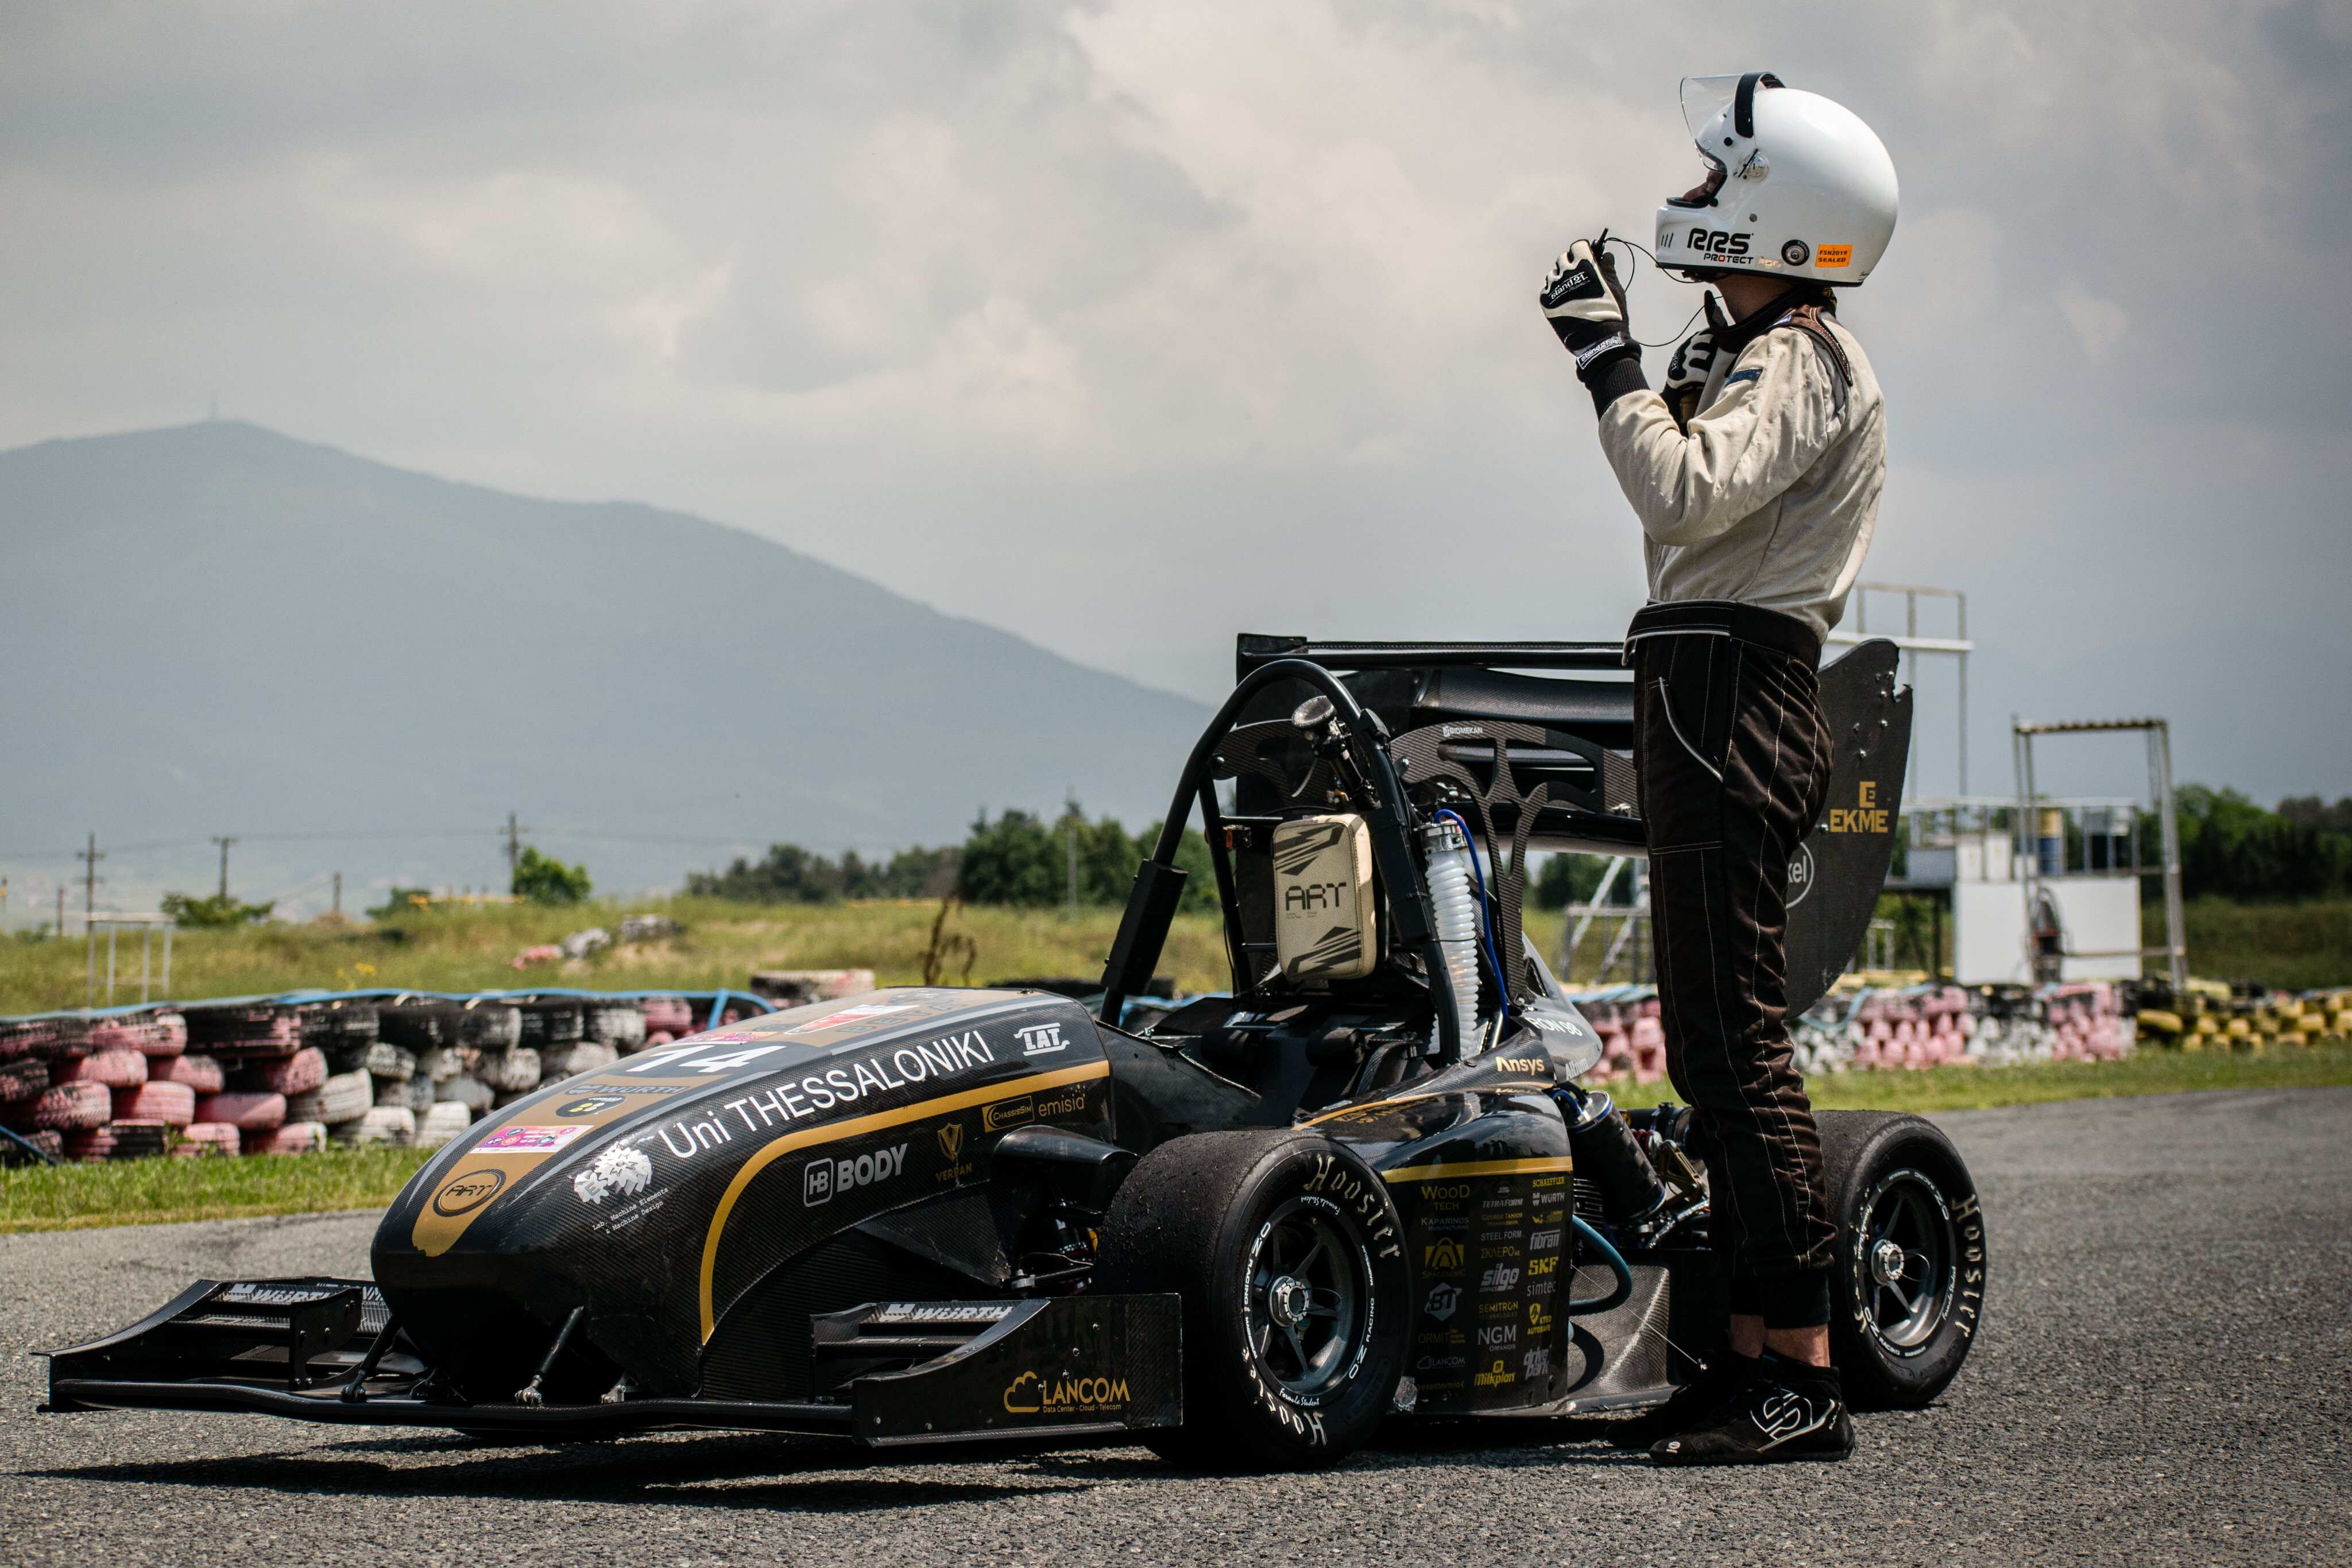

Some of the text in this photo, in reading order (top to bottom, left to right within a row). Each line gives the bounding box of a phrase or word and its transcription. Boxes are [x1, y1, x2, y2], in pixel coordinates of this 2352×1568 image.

[1686, 228, 1751, 254] RRS
[1703, 253, 1754, 264] PROTECT
[1829, 809, 1889, 833] EKME
[1285, 882, 1347, 911] ART
[625, 1045, 787, 1074] 14
[1496, 1056, 1545, 1075] Ansys
[659, 1031, 995, 1159] Uni THESSALONIKI
[1038, 1095, 1085, 1117] emisia
[836, 1144, 909, 1193] BODY
[447, 1184, 493, 1197] ART
[808, 1166, 830, 1196] HB
[1533, 1176, 1565, 1187] SCHAEFFLER
[593, 1187, 669, 1230] Lab. Machine Elements
[612, 1213, 639, 1231] Machine
[641, 1201, 664, 1215] Design
[1481, 1230, 1522, 1241] STEEL FORM
[1530, 1229, 1561, 1250] fibran
[1529, 1256, 1559, 1275] SKF
[1481, 1263, 1520, 1291] silgo
[1527, 1280, 1556, 1296] simtec
[912, 1306, 1013, 1320] WÜRTH
[1479, 1300, 1518, 1313] SEMITRON
[1365, 1298, 1374, 1342] RACING
[1477, 1325, 1517, 1345] NGM
[1432, 1356, 1465, 1365] LANCOM
[1474, 1371, 1515, 1387] milkplan
[1043, 1378, 1131, 1404] LANCOM
